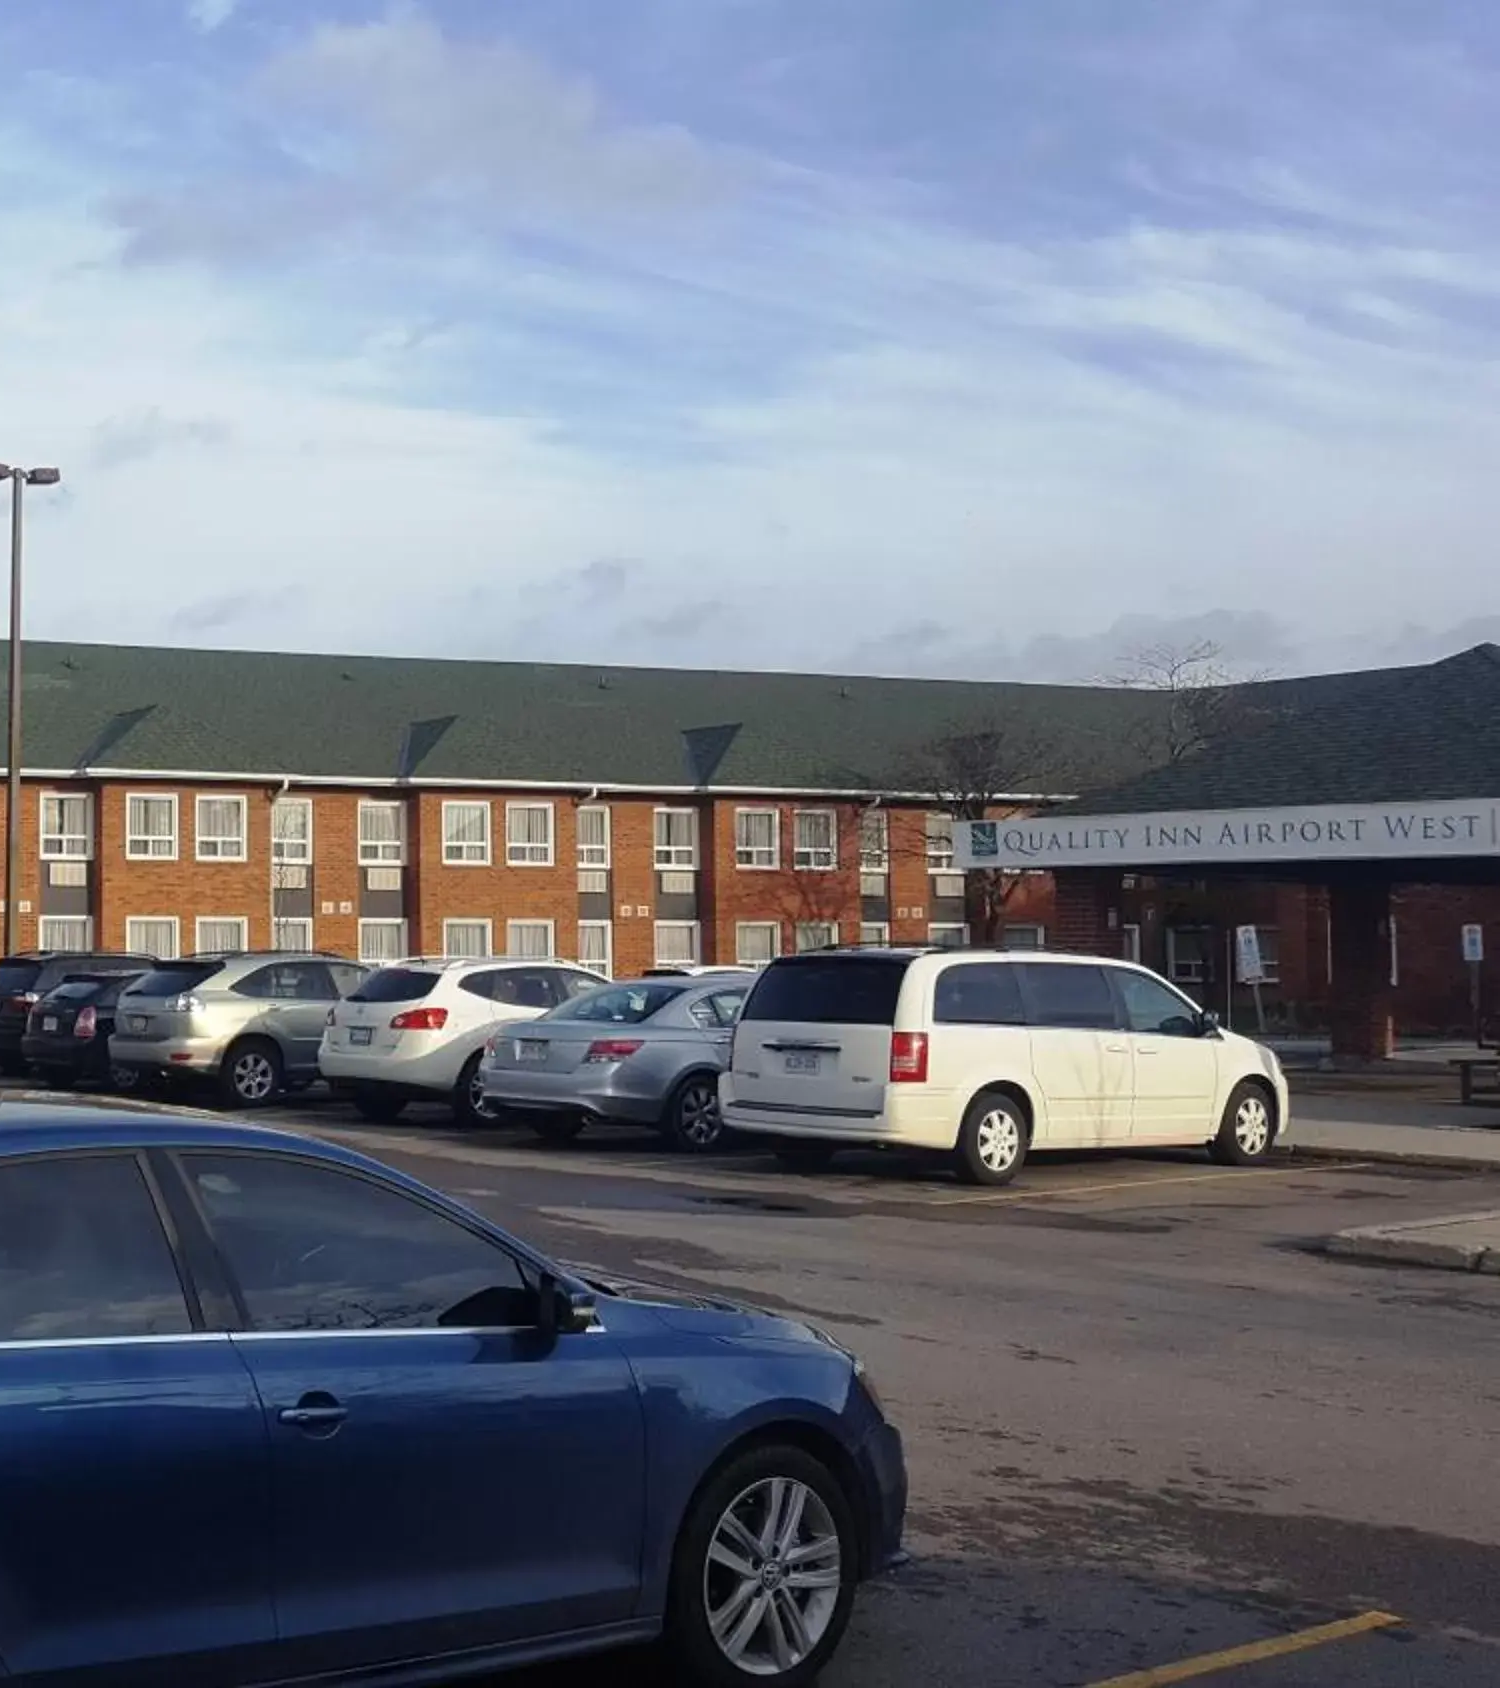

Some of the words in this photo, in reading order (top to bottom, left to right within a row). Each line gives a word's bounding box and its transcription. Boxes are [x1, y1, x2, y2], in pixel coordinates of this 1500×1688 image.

[1003, 828, 1129, 856] QUALITY
[1145, 825, 1202, 846] INN
[1219, 819, 1366, 844] AIRPORT
[1383, 814, 1481, 840] WEST
